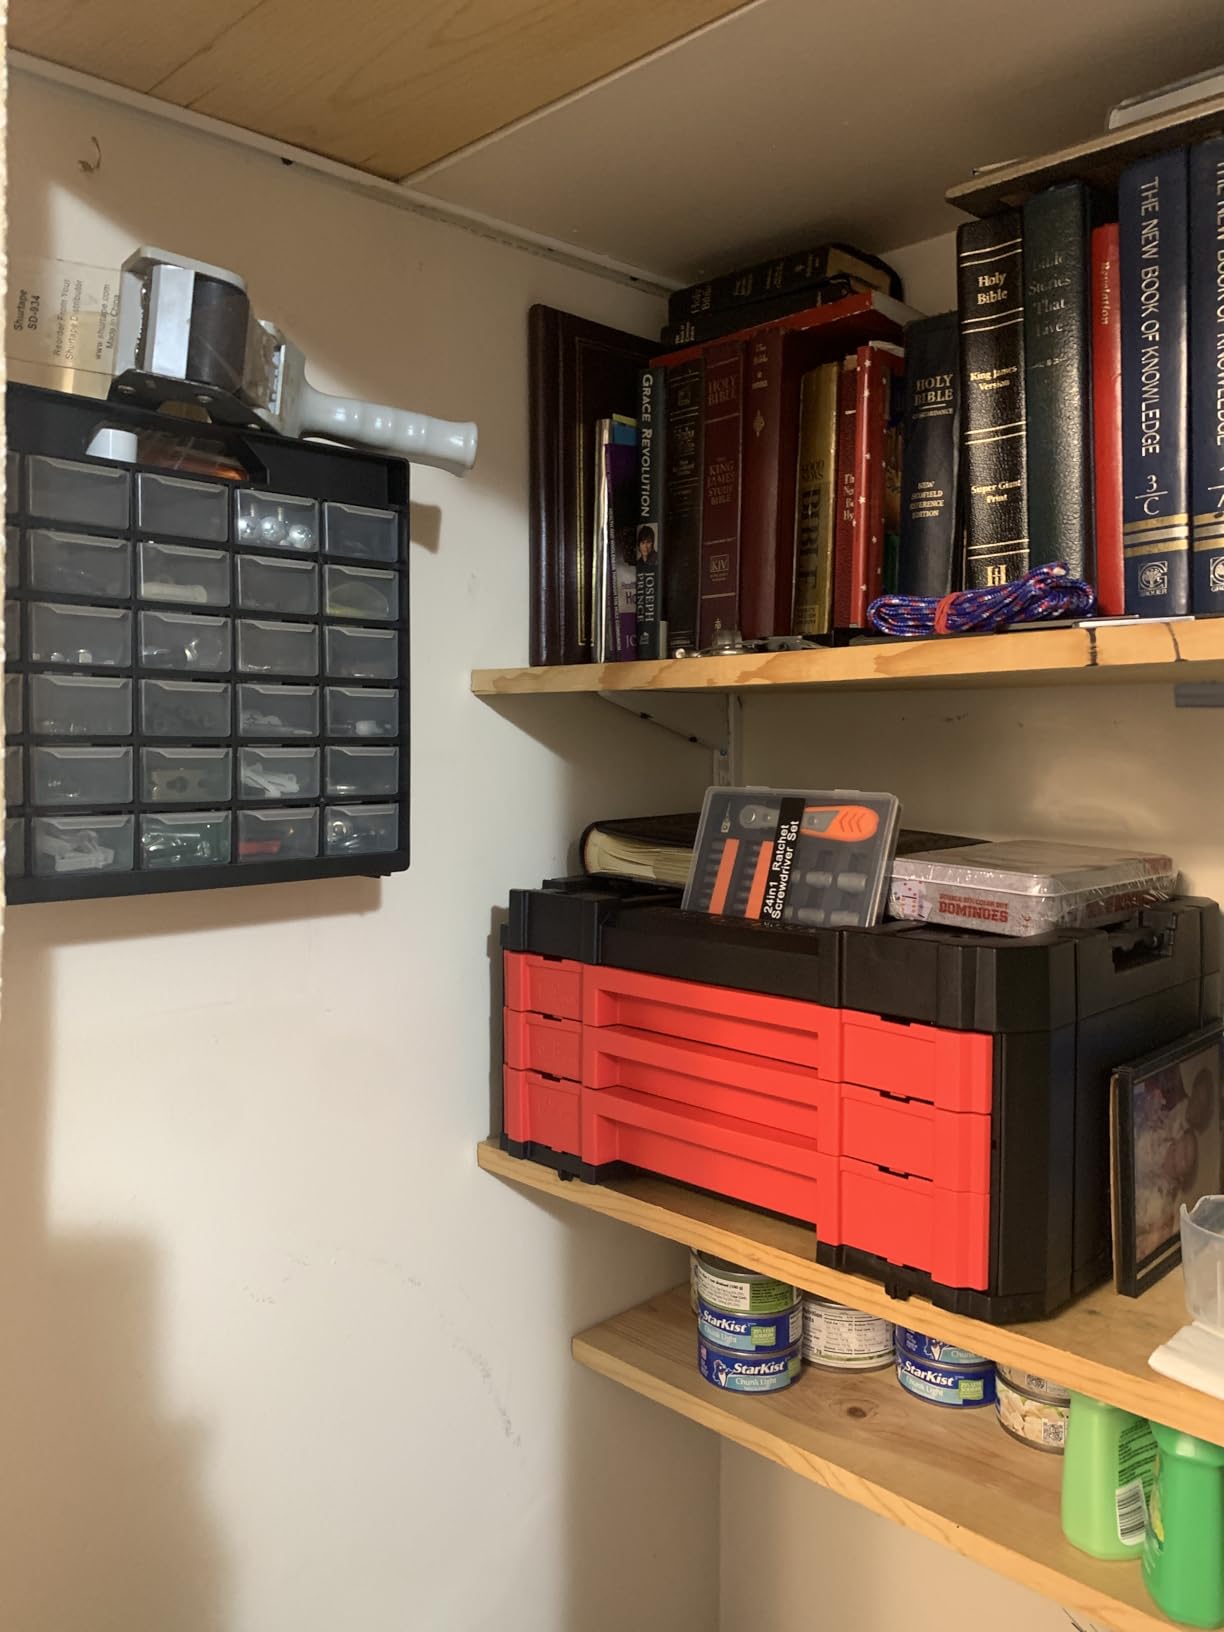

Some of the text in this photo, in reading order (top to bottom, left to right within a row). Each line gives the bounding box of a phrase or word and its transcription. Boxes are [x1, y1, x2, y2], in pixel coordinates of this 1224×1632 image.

[977, 271, 1007, 288] Holy
[1028, 274, 1072, 297] Stories
[976, 288, 1008, 305] Bible
[1100, 261, 1111, 325] Revelation
[13, 288, 28, 332] Shurtape
[27, 294, 40, 331] SD-934
[1032, 297, 1066, 315] That
[1140, 175, 1161, 457] THE NEW BOOK OF KNOWLEDGE
[916, 373, 954, 391] HOLY
[970, 365, 1018, 382] King James
[979, 378, 1010, 391] Version
[913, 388, 954, 406] BIBLE
[640, 373, 653, 517] GRACE REVOLUTION
[709, 461, 735, 476] KING
[971, 479, 1022, 496] Super Giant
[1146, 474, 1158, 493] 3
[986, 494, 1008, 504] Print
[1143, 496, 1160, 516] C
[636, 572, 645, 623] PRINCE
[644, 571, 656, 622] JOSEPH
[763, 824, 790, 914] 24in1 Ratchet
[771, 820, 799, 920] Screwdriver Set
[938, 900, 1009, 923] DOMINOES
[703, 1310, 748, 1334] StarKist
[703, 1325, 737, 1344] Chunk Light
[733, 1361, 785, 1376] StarKist
[904, 1360, 955, 1387] StarKist
[735, 1376, 777, 1388] Chunk Light
[906, 1375, 924, 1391] Chunk
[926, 1384, 944, 1397] Light
